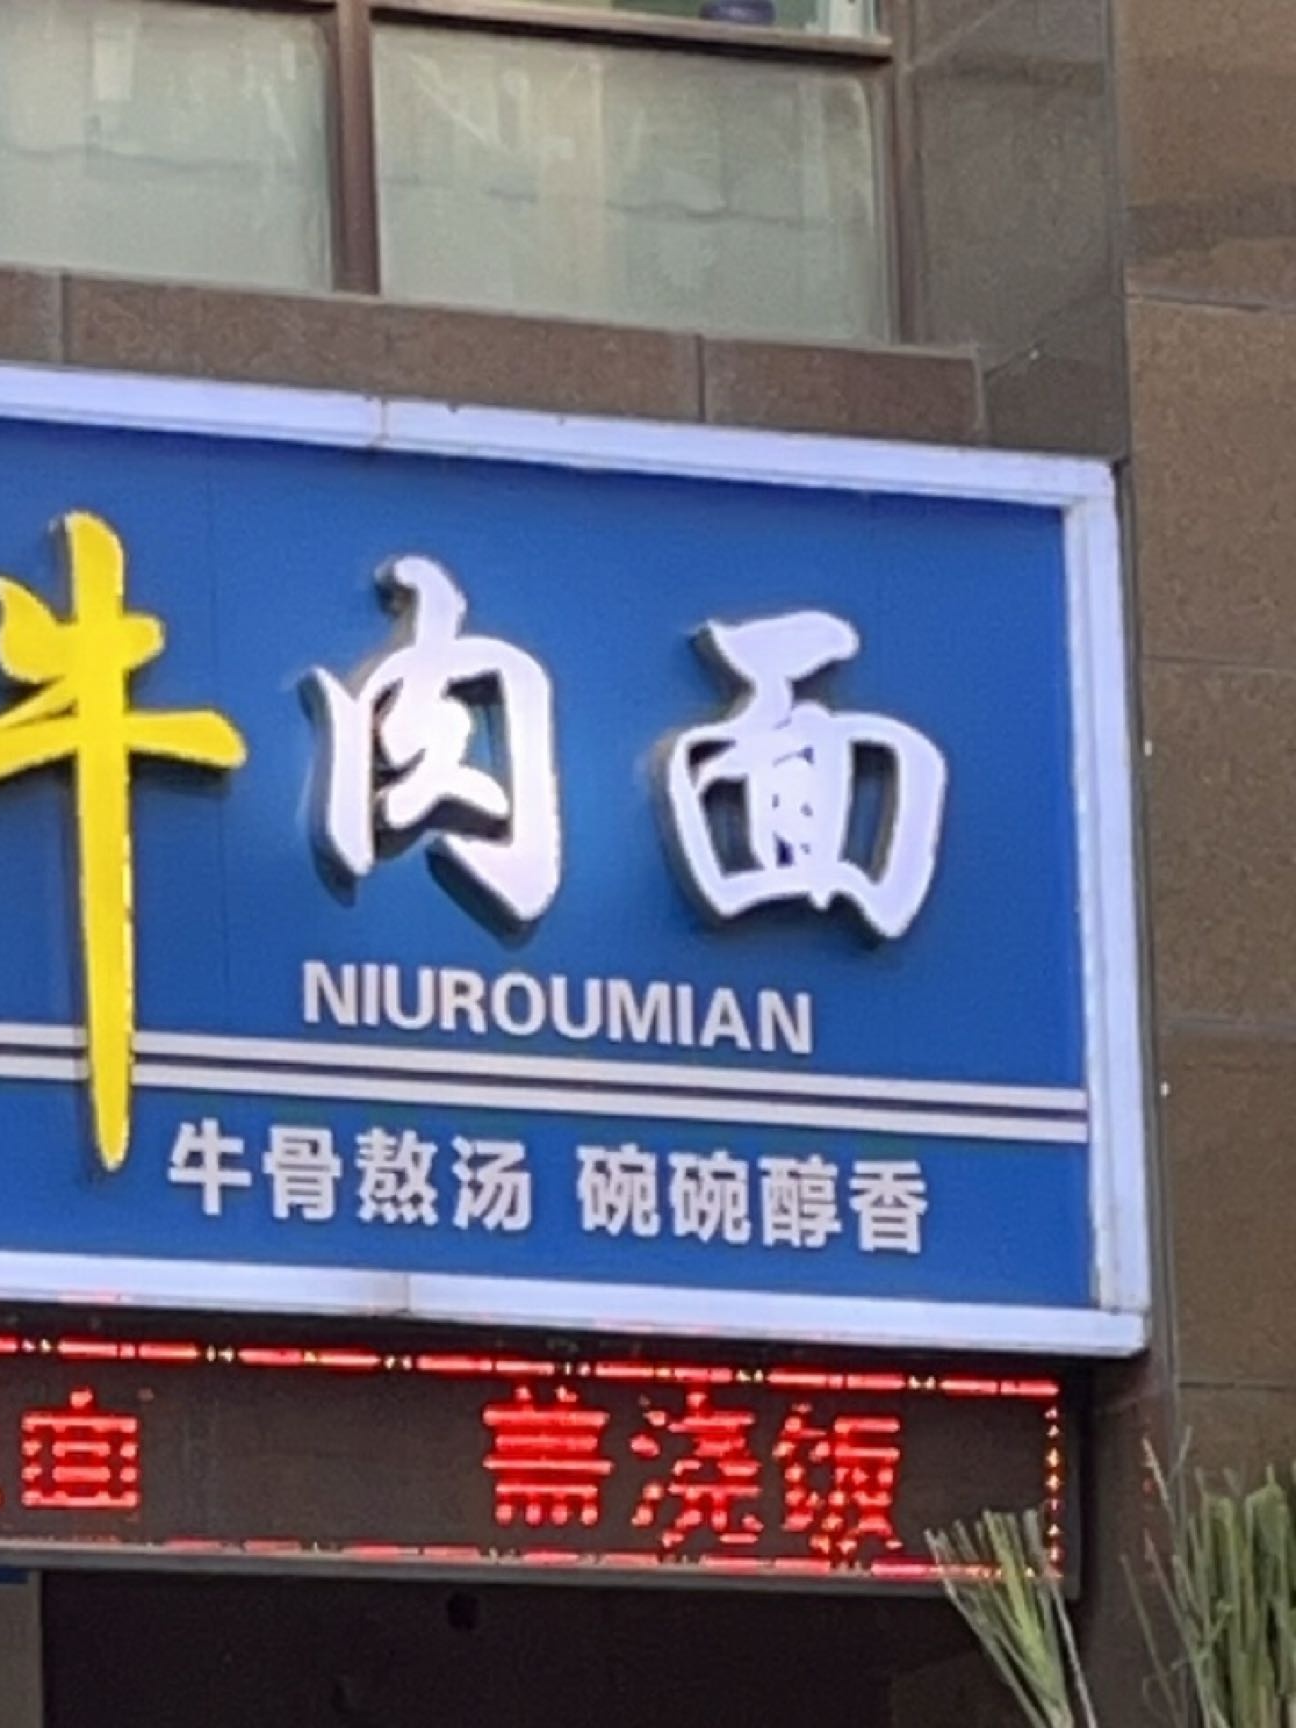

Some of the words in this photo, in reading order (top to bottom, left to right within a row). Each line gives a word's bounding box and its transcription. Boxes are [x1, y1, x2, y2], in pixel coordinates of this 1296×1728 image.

[302, 959, 814, 1055] NIUROUMIAN
[168, 1118, 533, 1233] 牛骨熬汤
[576, 1142, 929, 1254] 碗碗醇香
